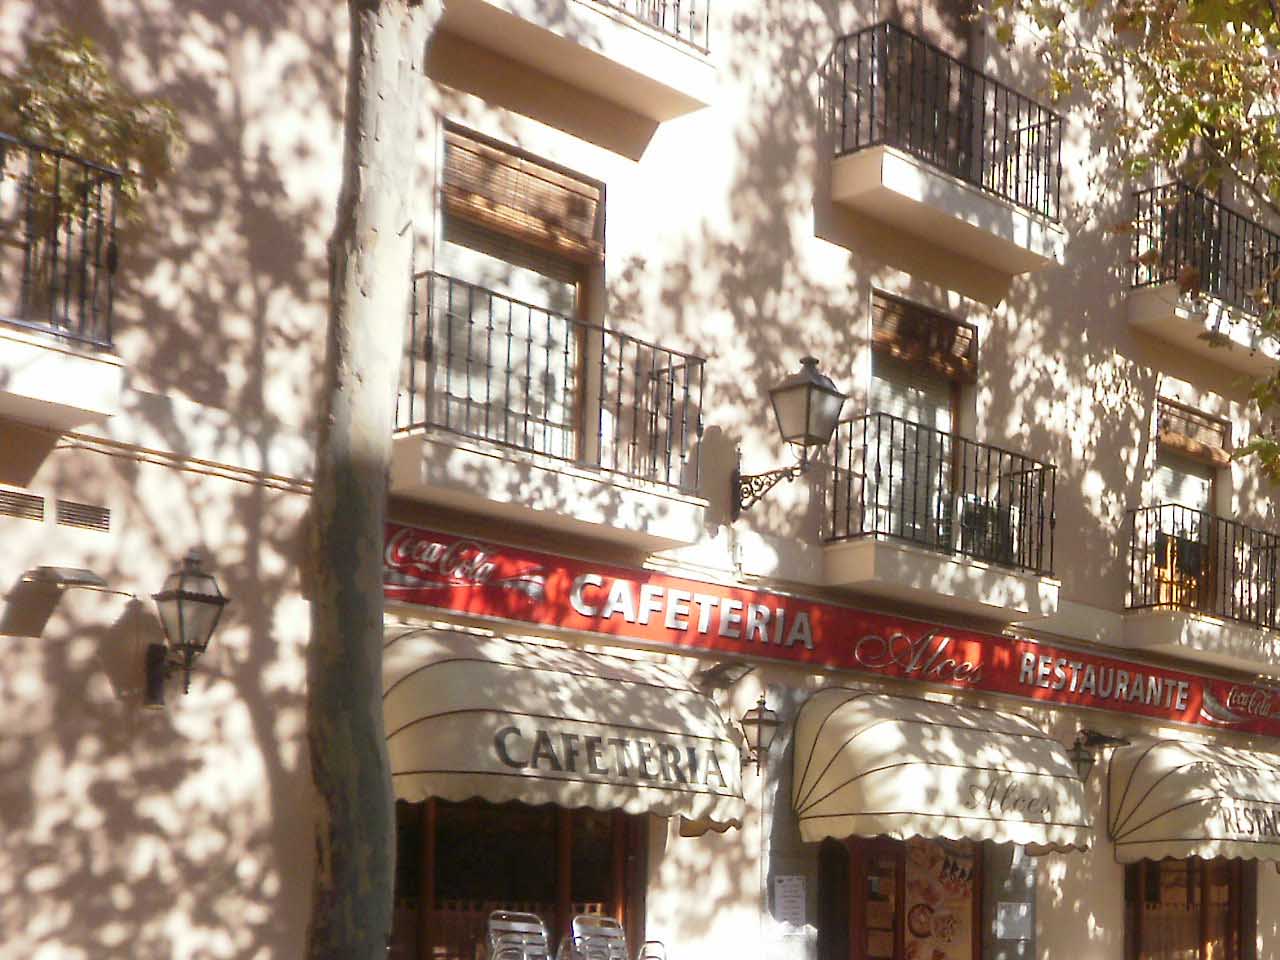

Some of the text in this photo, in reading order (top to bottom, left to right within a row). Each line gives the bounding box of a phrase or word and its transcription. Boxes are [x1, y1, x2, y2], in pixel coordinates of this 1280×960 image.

[569, 574, 815, 650] CAFETERIA
[1019, 653, 1190, 711] RESTAURANTE
[493, 727, 729, 789] CAFETERIA
